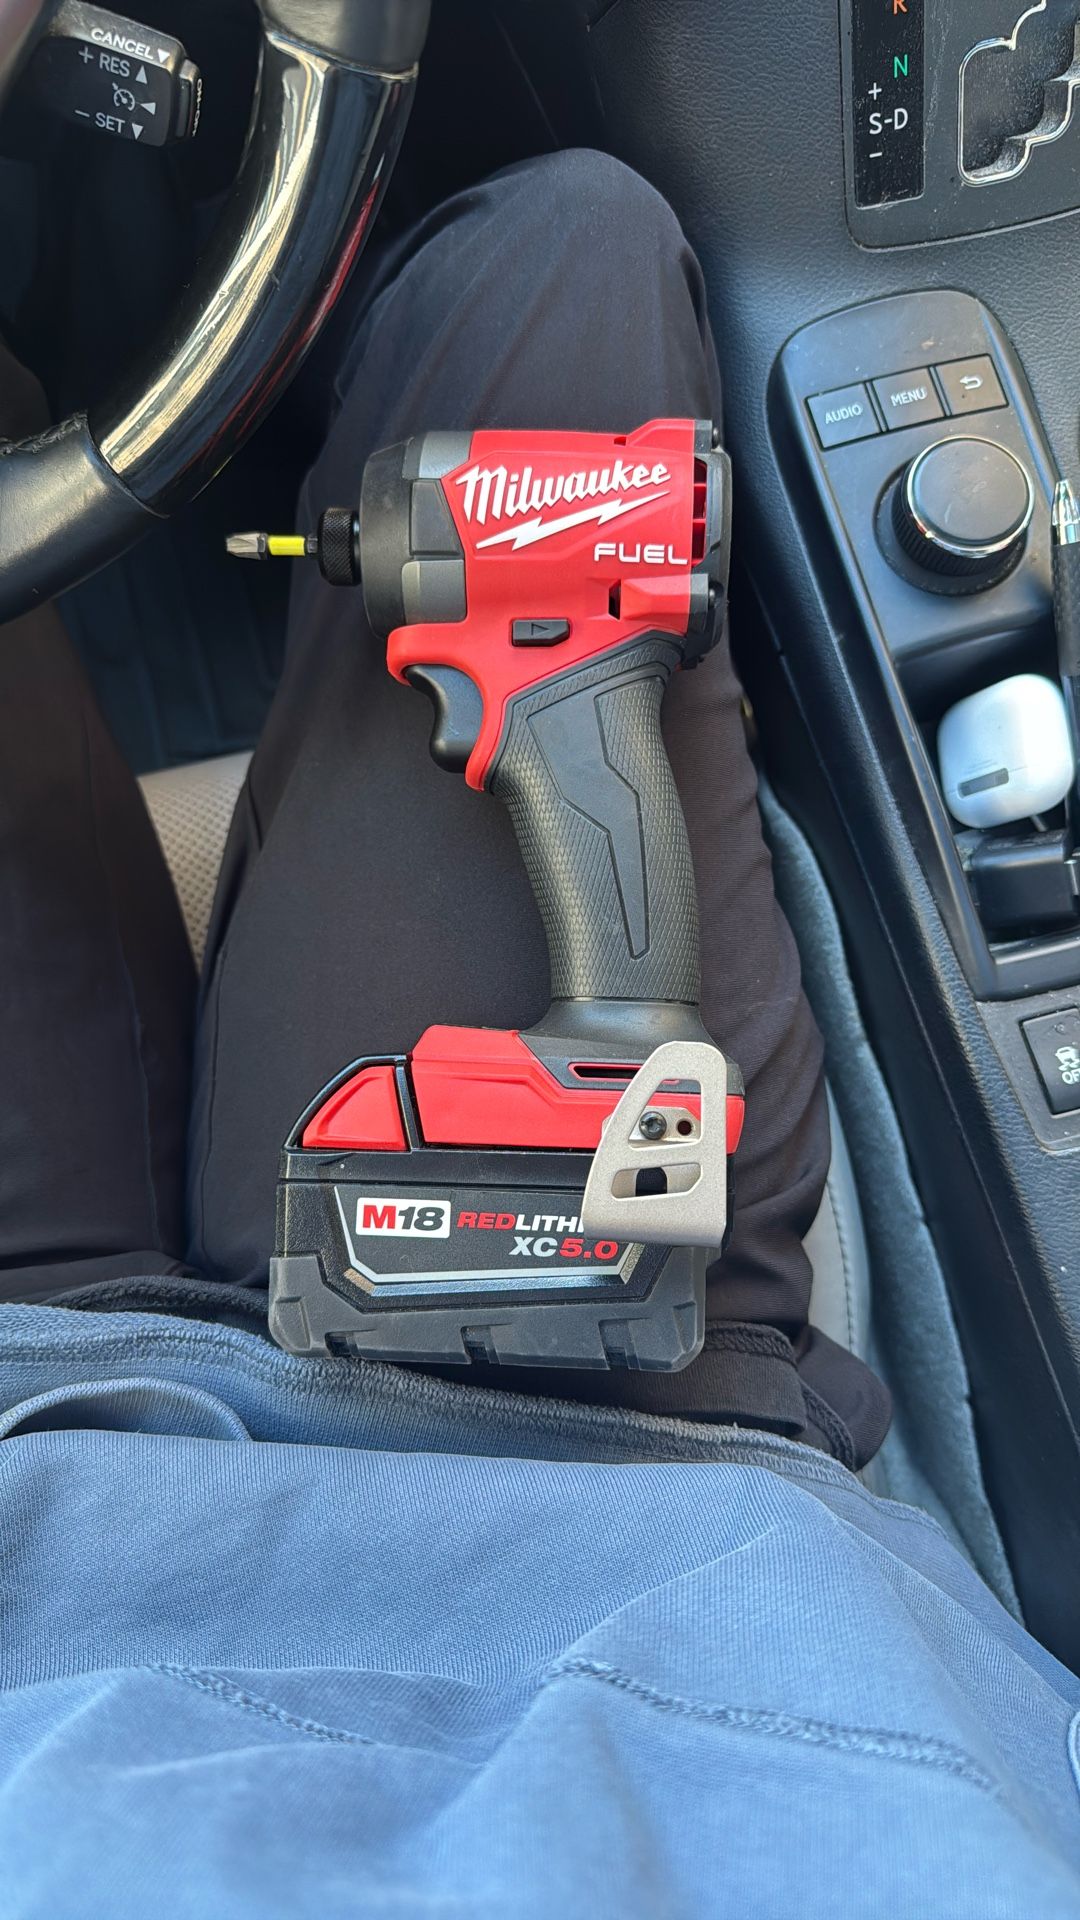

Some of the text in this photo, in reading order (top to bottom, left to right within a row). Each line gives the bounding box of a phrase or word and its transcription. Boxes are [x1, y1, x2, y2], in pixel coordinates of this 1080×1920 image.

[893, 0, 907, 14] R
[91, 28, 153, 59] CANCEL
[99, 53, 130, 77] RES
[894, 54, 908, 78] N
[868, 82, 882, 100] +
[95, 112, 125, 134] SET
[869, 108, 908, 135] S-D
[890, 387, 927, 406] MENU
[824, 404, 863, 425] AUDIO
[456, 460, 671, 525] Milwaukee
[594, 543, 688, 565] FUEL
[1062, 1068, 1080, 1084] OF
[362, 1204, 445, 1231] M18
[457, 1211, 584, 1233] REDLITHI
[508, 1236, 619, 1260] XC5.0
